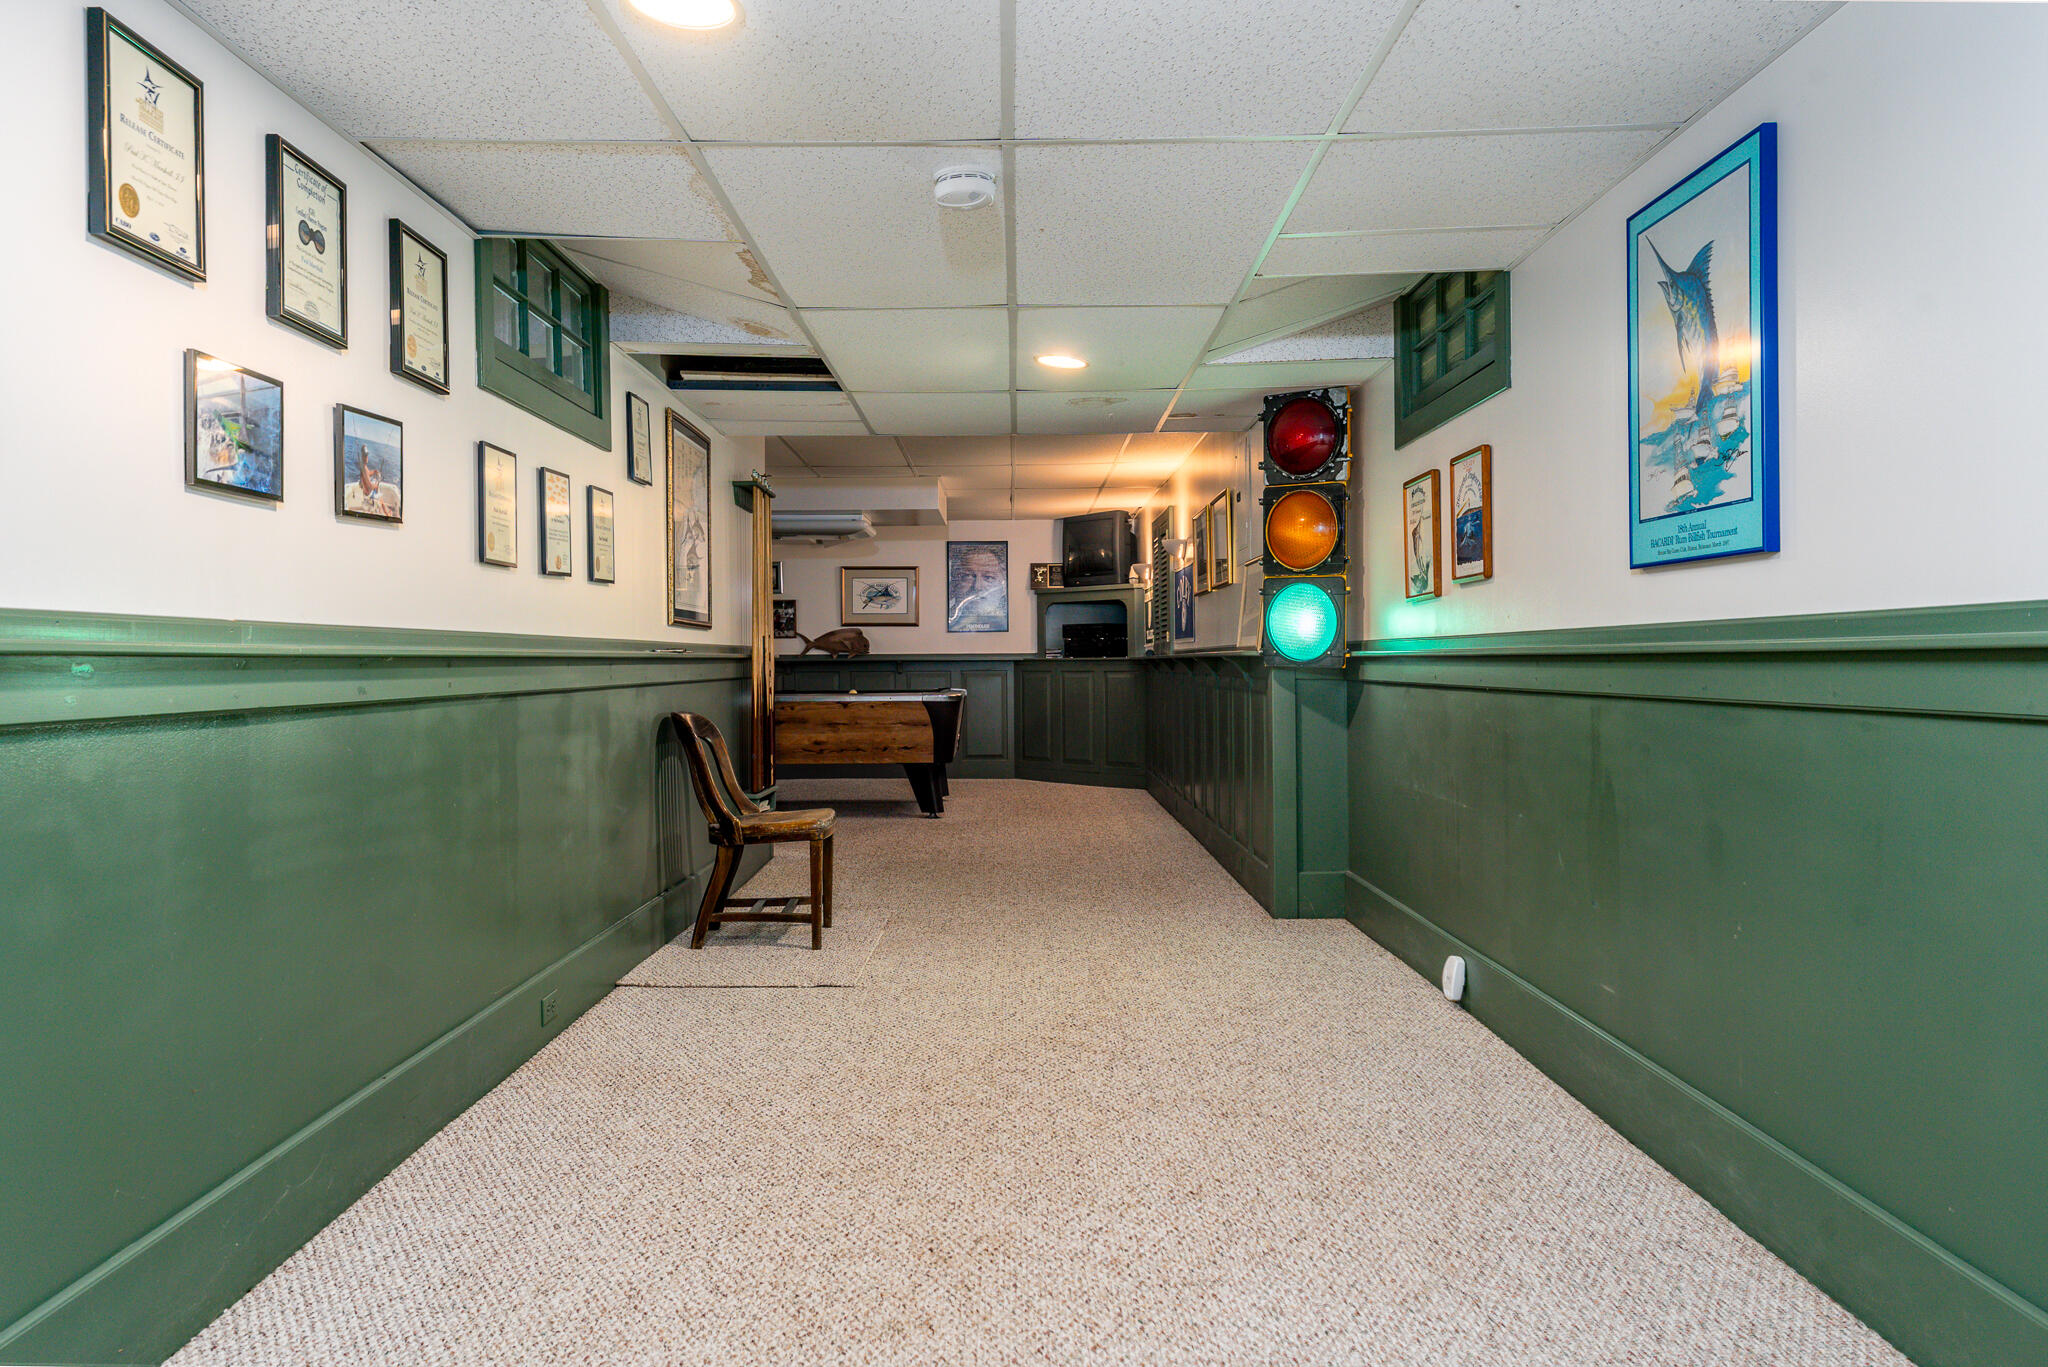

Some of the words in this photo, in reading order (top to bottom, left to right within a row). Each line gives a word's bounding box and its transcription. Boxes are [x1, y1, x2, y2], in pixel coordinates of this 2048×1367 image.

[294, 163, 321, 190] Certificate
[321, 184, 329, 198] of
[297, 177, 326, 205] Completion
[1689, 519, 1707, 532] Annual
[1706, 527, 1738, 540] Tournament
